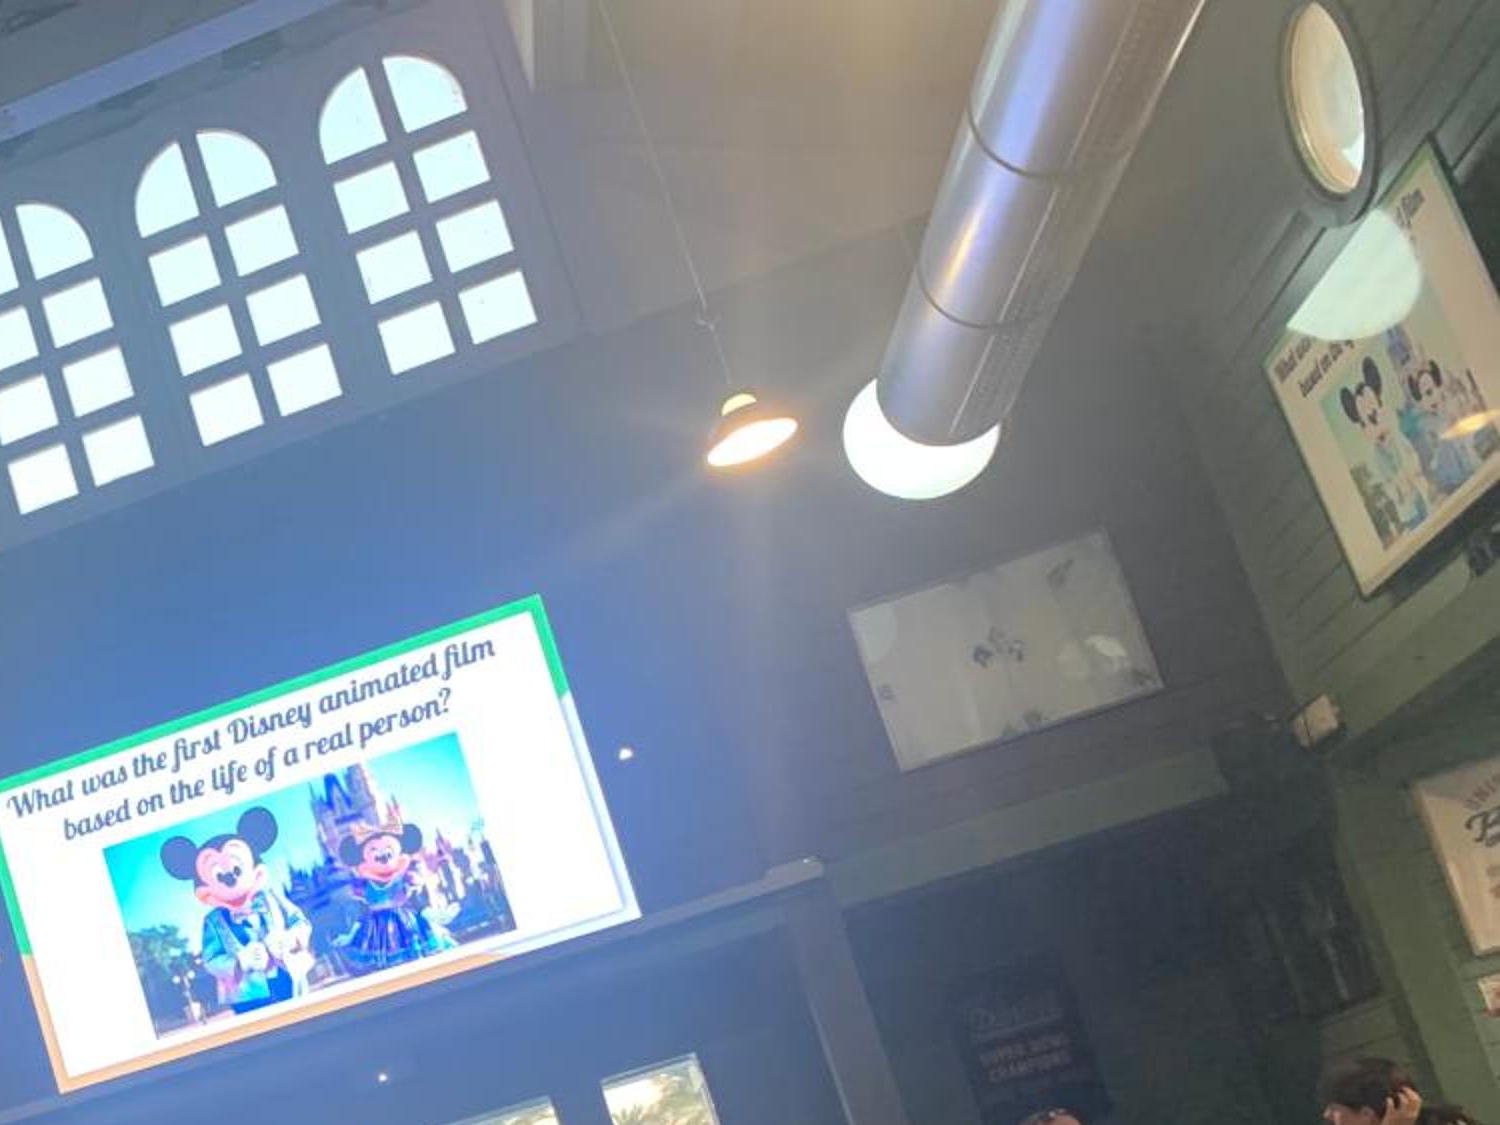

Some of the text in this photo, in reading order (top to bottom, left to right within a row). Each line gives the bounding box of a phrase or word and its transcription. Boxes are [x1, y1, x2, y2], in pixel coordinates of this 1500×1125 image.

[6, 639, 495, 818] What was the first Disney animated film
[63, 687, 451, 840] based on the life of a real person?
